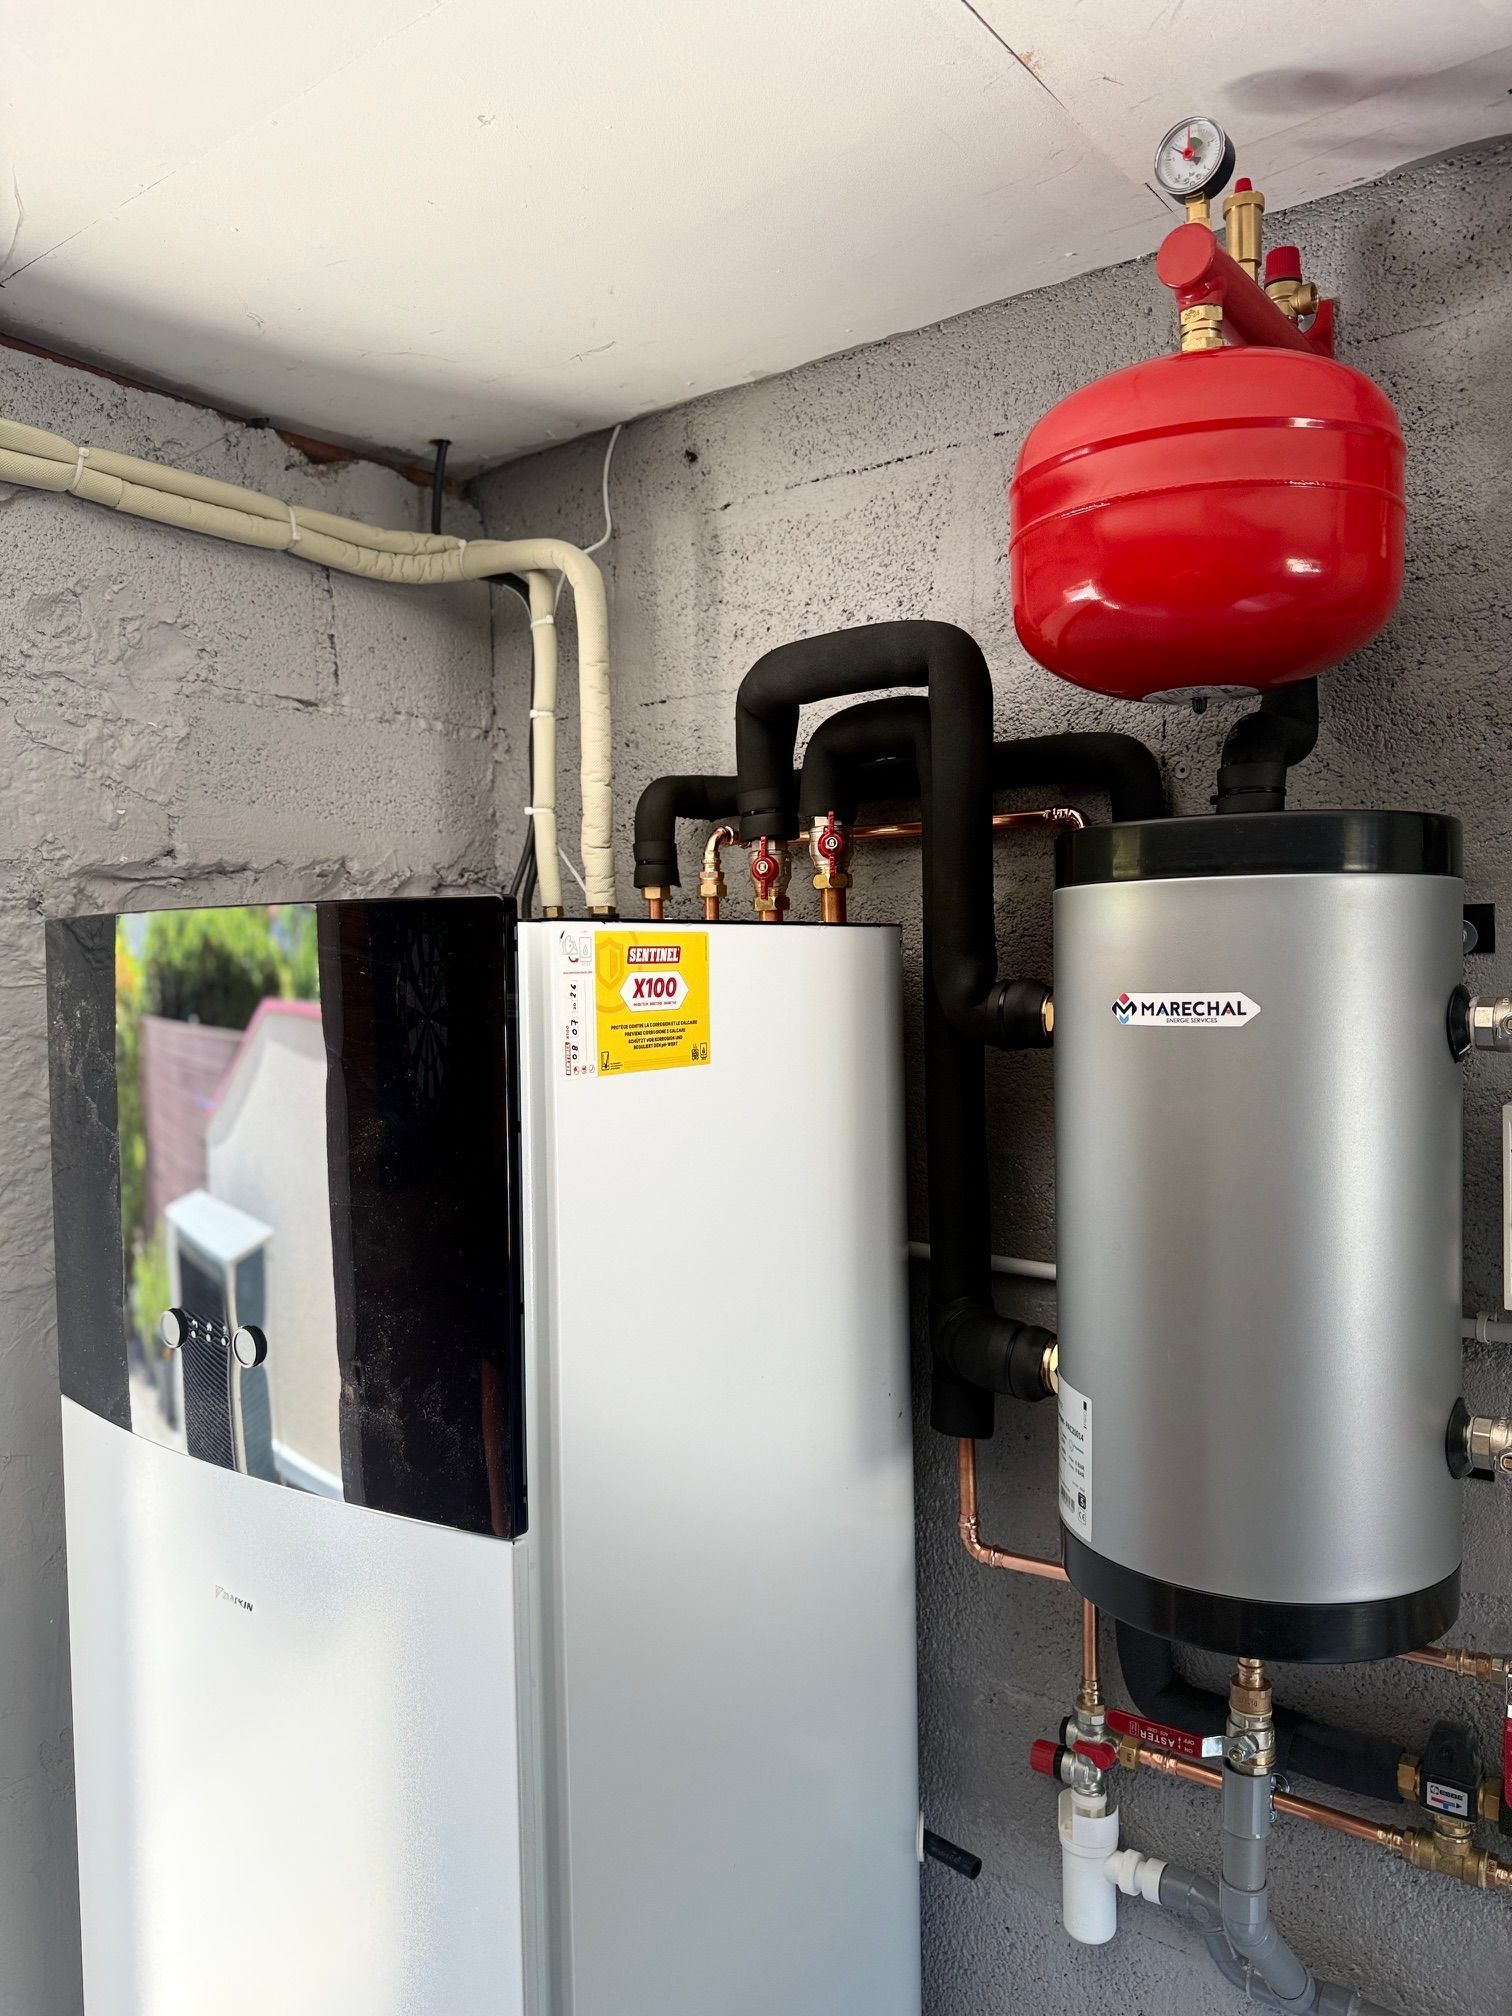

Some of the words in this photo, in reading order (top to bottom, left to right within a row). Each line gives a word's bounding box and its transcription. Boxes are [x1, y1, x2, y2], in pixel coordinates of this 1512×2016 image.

[629, 947, 679, 963] SENTINEL
[633, 977, 677, 999] X100
[1141, 1000, 1247, 1017] MARECHAL
[1140, 1729, 1175, 1747] ASTER
[1183, 1738, 1195, 1746] OFF
